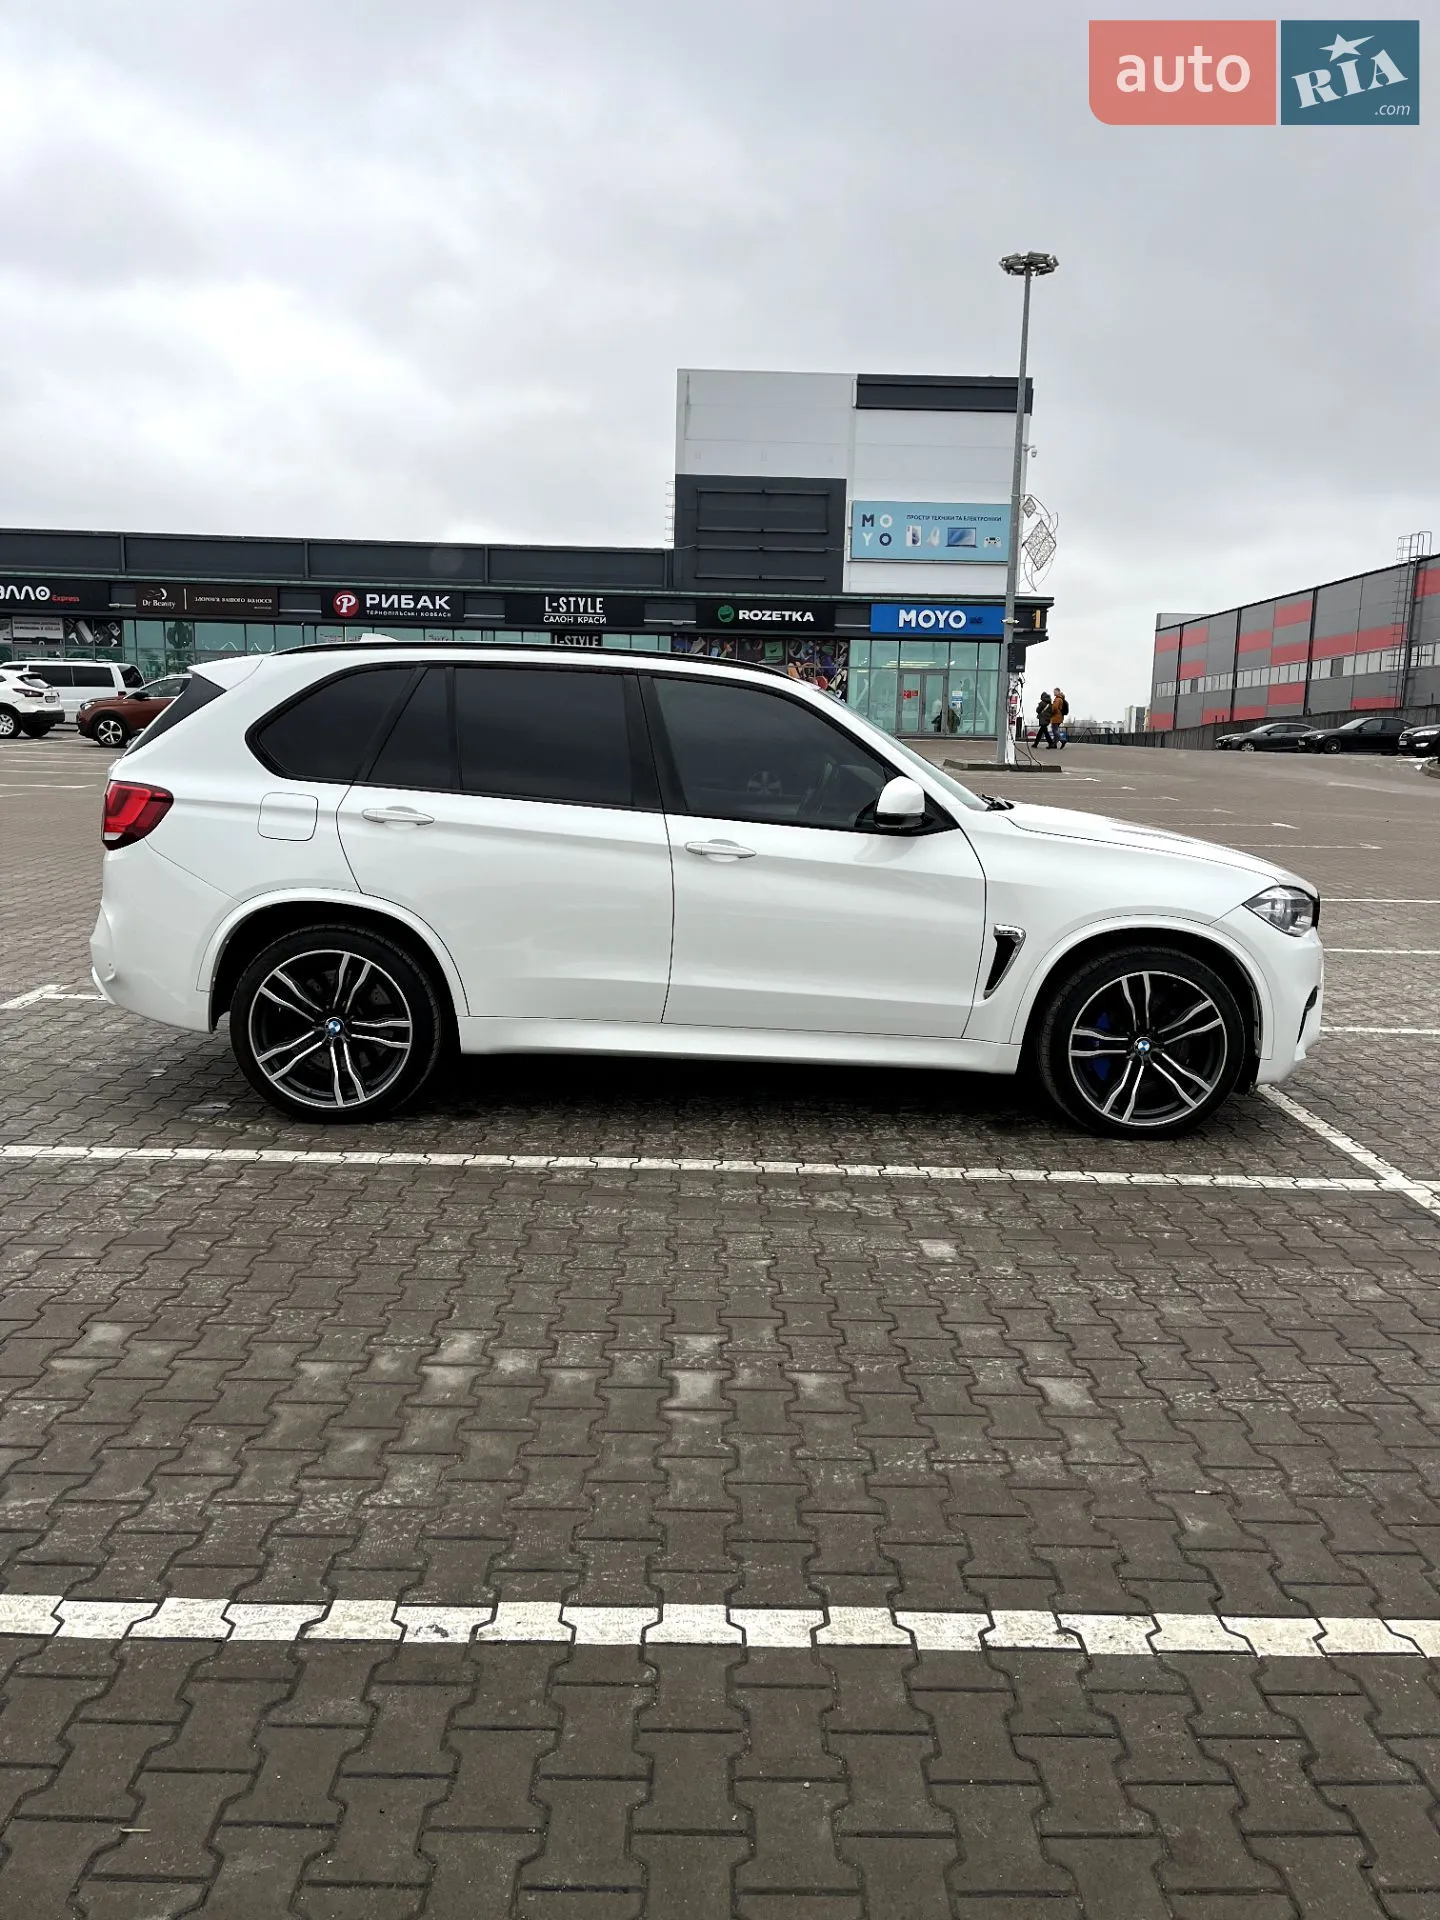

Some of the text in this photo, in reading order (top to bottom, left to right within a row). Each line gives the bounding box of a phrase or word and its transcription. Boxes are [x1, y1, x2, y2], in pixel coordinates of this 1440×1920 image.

[142, 599, 176, 609] Dr Beauty
[365, 594, 451, 610] РИБАК
[545, 596, 604, 613] L-STYLE
[543, 615, 607, 624] САЛОН КРАСИ
[738, 610, 815, 622] ROZETKA
[898, 609, 967, 629] MOYO
